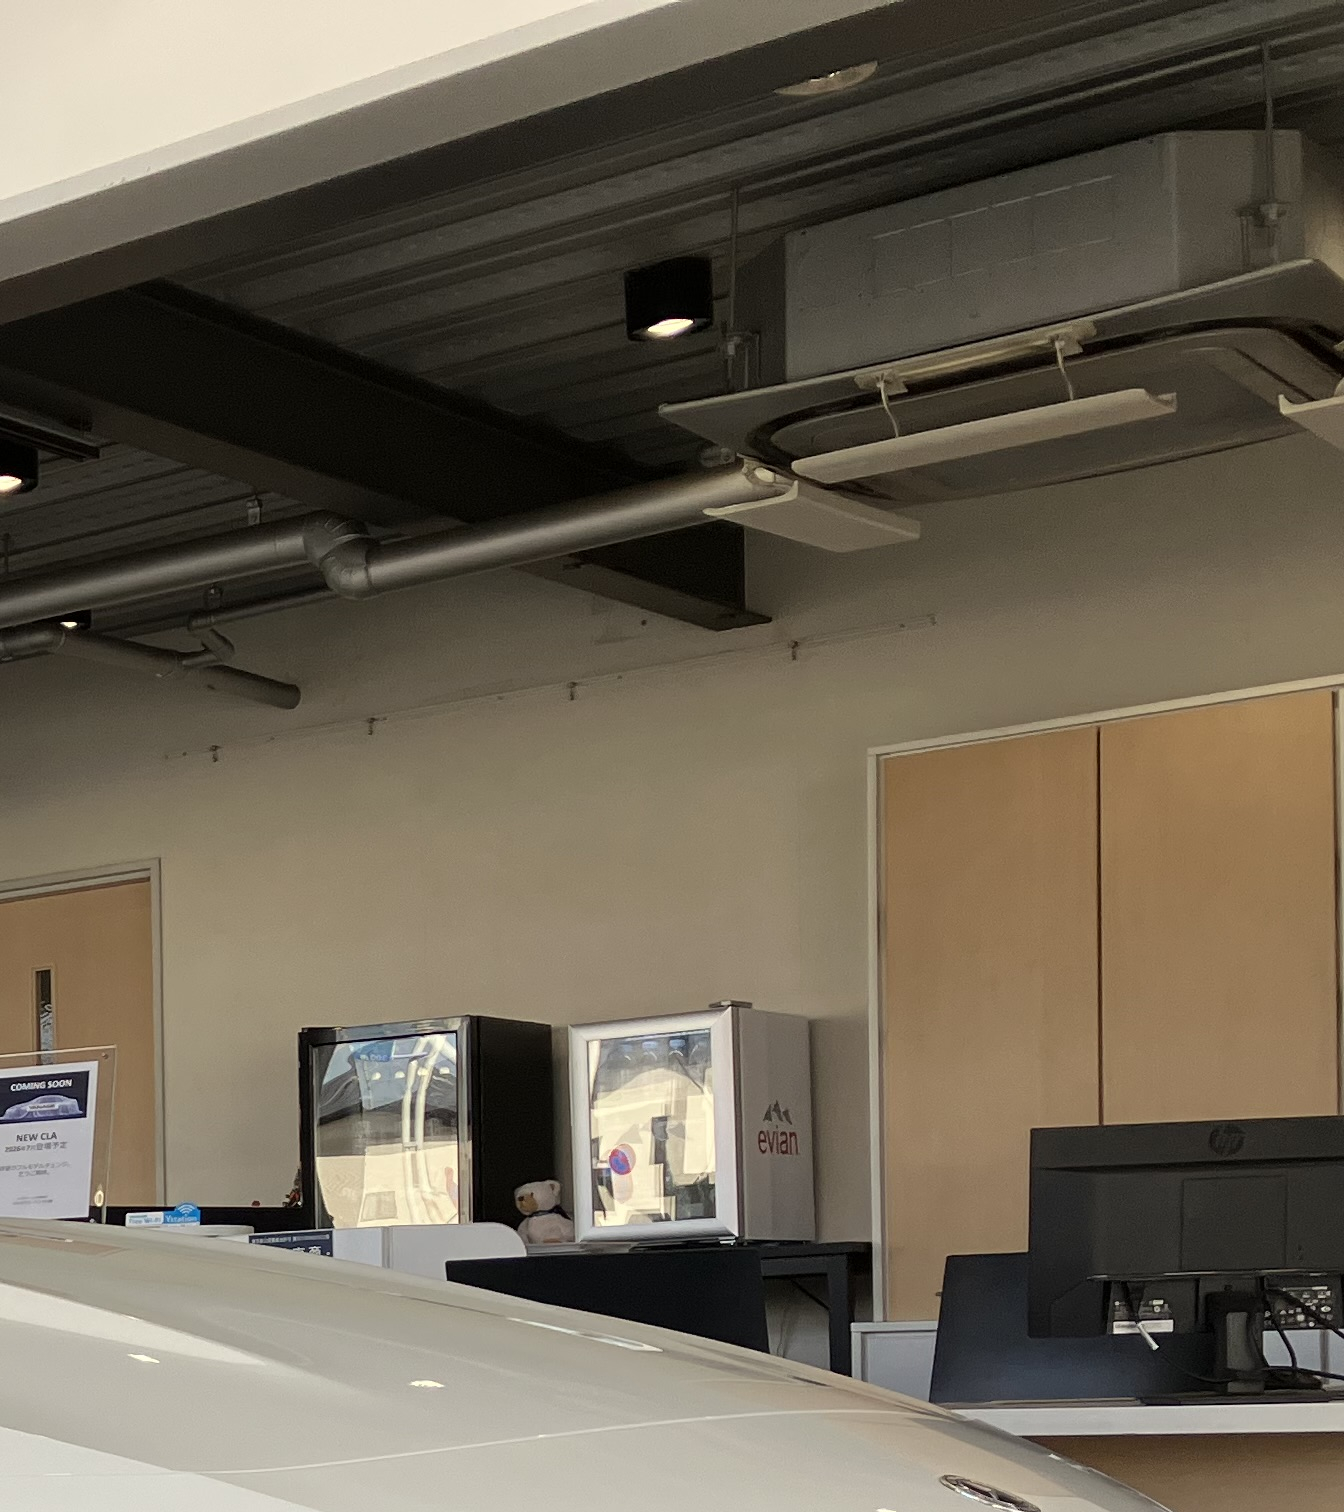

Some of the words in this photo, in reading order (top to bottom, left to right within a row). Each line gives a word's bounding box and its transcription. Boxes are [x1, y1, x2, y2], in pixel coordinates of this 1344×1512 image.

[10, 1081, 46, 1092] COMING
[47, 1079, 73, 1089] SOON
[16, 1133, 38, 1142] NEW
[40, 1131, 58, 1141] CLA
[757, 1127, 799, 1155] evian
